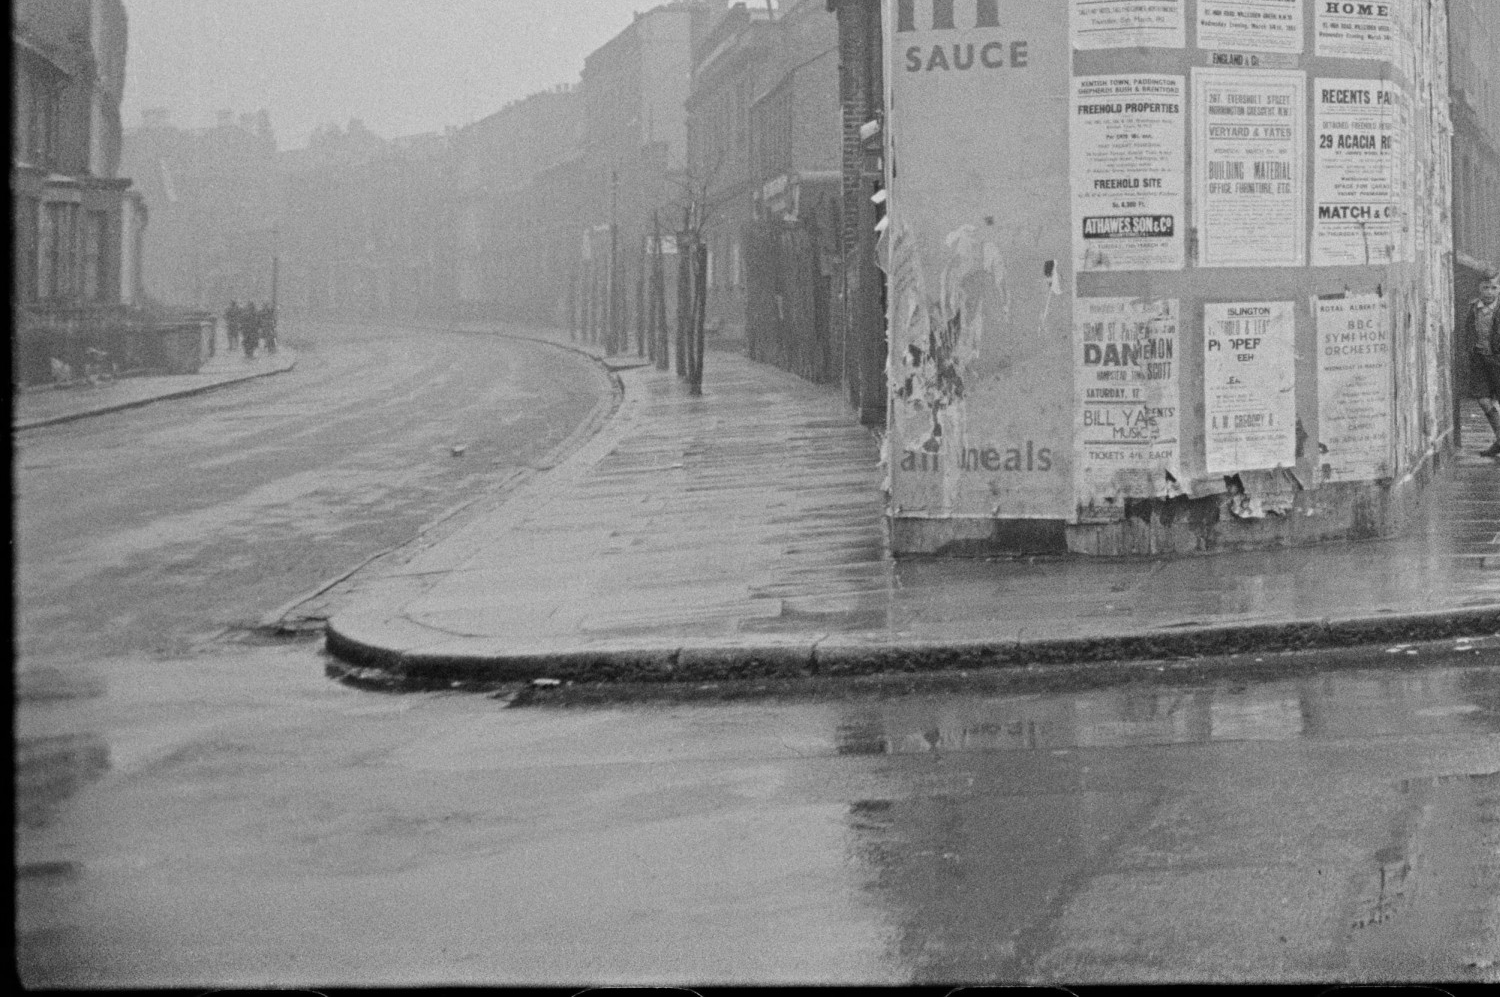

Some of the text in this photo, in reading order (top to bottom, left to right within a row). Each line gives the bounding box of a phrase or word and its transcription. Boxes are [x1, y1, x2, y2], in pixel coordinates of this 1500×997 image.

[905, 40, 1029, 73] SAUCE
[1212, 52, 1244, 66] ENGLAND
[1133, 78, 1176, 87] PADDINGTON
[1266, 94, 1290, 106] STREET
[1078, 102, 1180, 115] FREEHOLD PROPERTIES
[1208, 126, 1293, 138] VERYARD & YATES
[1319, 133, 1334, 149] 29
[1337, 133, 1377, 150] ACACIA
[1208, 160, 1292, 181] BUILDING MATERIAL
[1093, 177, 1163, 190] FREEHOLD SITE
[1208, 182, 1233, 195] OFFICE
[1318, 205, 1372, 220] MATCH
[1373, 208, 1381, 220] &
[1132, 216, 1154, 234] SON
[1227, 306, 1271, 316] ISLINGTON
[1319, 305, 1344, 313] ROYAL
[1349, 303, 1377, 312] ALBERT
[1347, 319, 1374, 330] BBC
[1146, 360, 1172, 381] SCOTT
[1082, 409, 1116, 427] BILL
[1112, 426, 1150, 440] MUSIC
[1088, 450, 1126, 460] TICKETS
[1149, 450, 1174, 461] EACH
